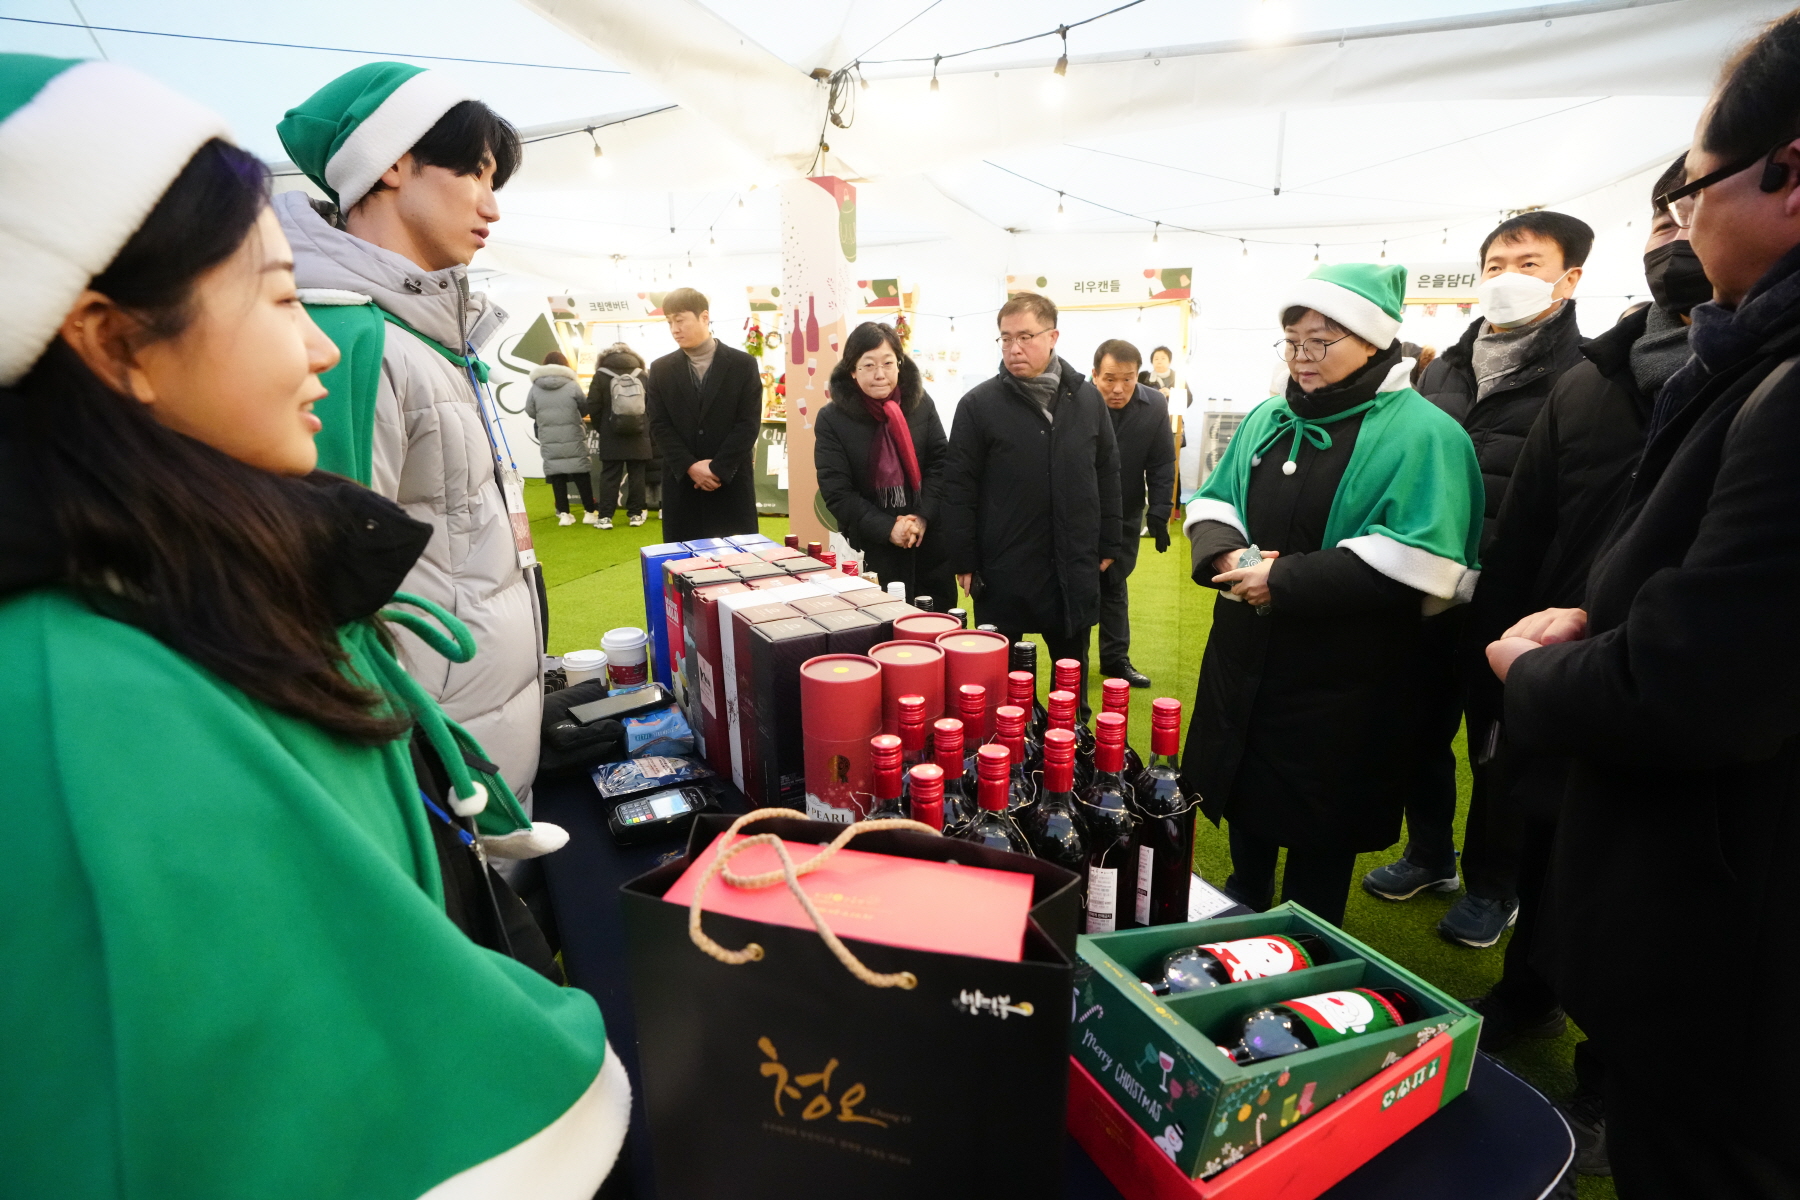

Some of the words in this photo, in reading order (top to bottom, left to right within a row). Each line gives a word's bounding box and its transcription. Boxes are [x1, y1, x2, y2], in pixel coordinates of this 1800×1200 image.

[1074, 279, 1121, 293] 리우캔들
[1417, 273, 1476, 288] 은을담다
[589, 300, 630, 312] 크림앤버터
[1114, 1062, 1162, 1122] CHRISTMAS
